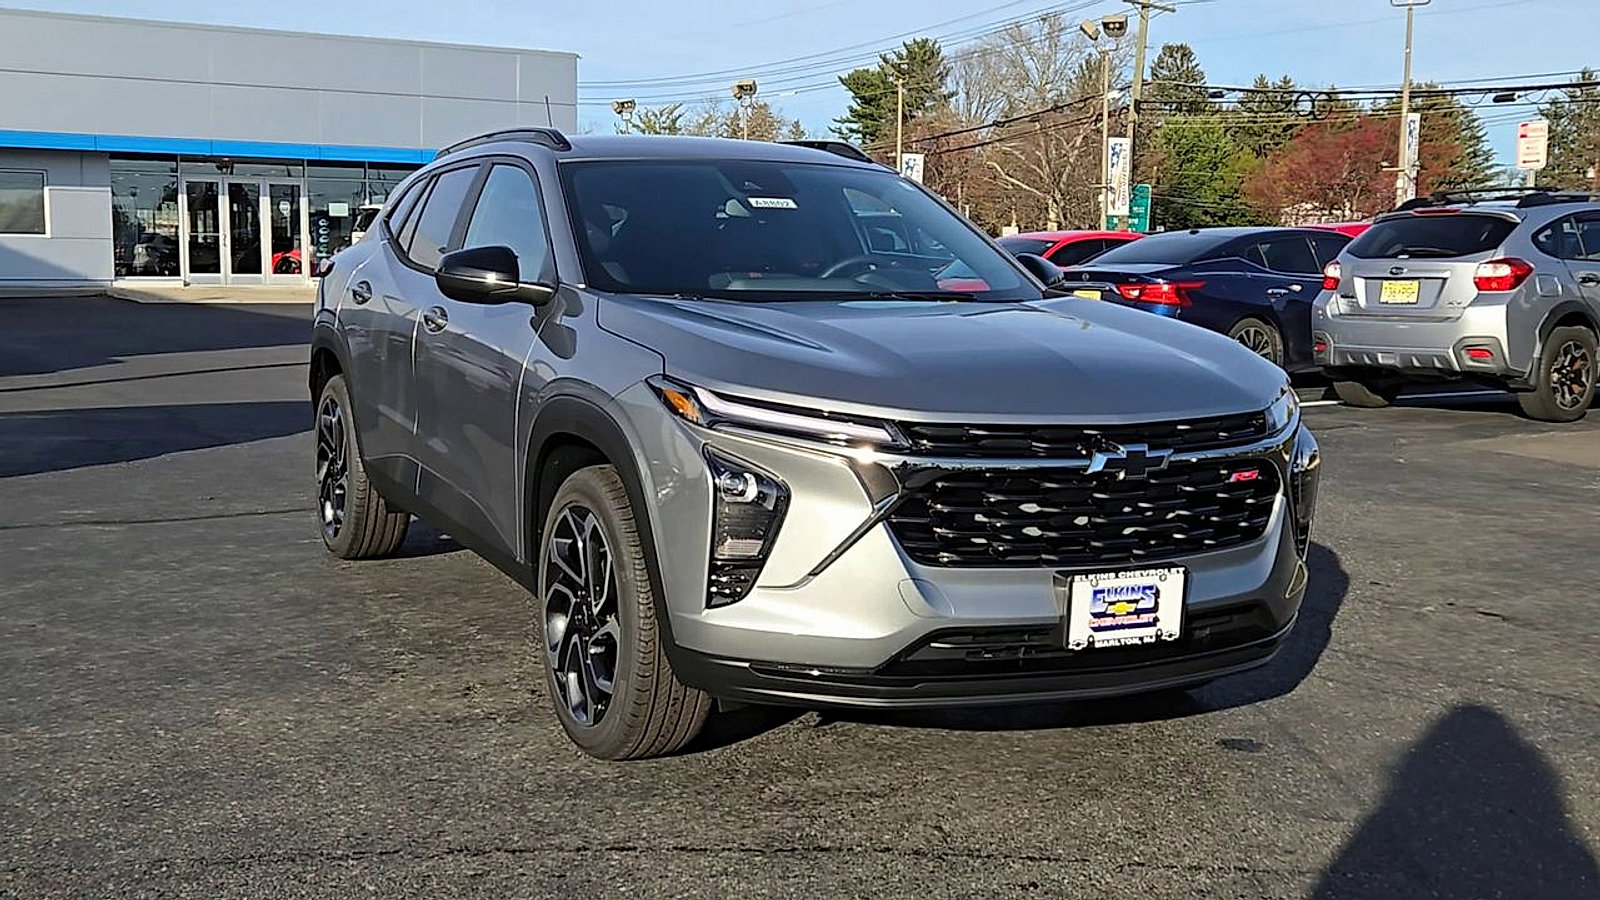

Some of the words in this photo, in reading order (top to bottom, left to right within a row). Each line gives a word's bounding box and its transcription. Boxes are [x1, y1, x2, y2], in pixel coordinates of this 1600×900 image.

[1230, 470, 1259, 482] RS
[1073, 573, 1116, 582] ELKINS
[1118, 567, 1185, 579] CHEVROLET
[1090, 583, 1157, 613] ELKINS
[1094, 637, 1142, 648] MARLTON,
[1143, 635, 1156, 643] NJ
